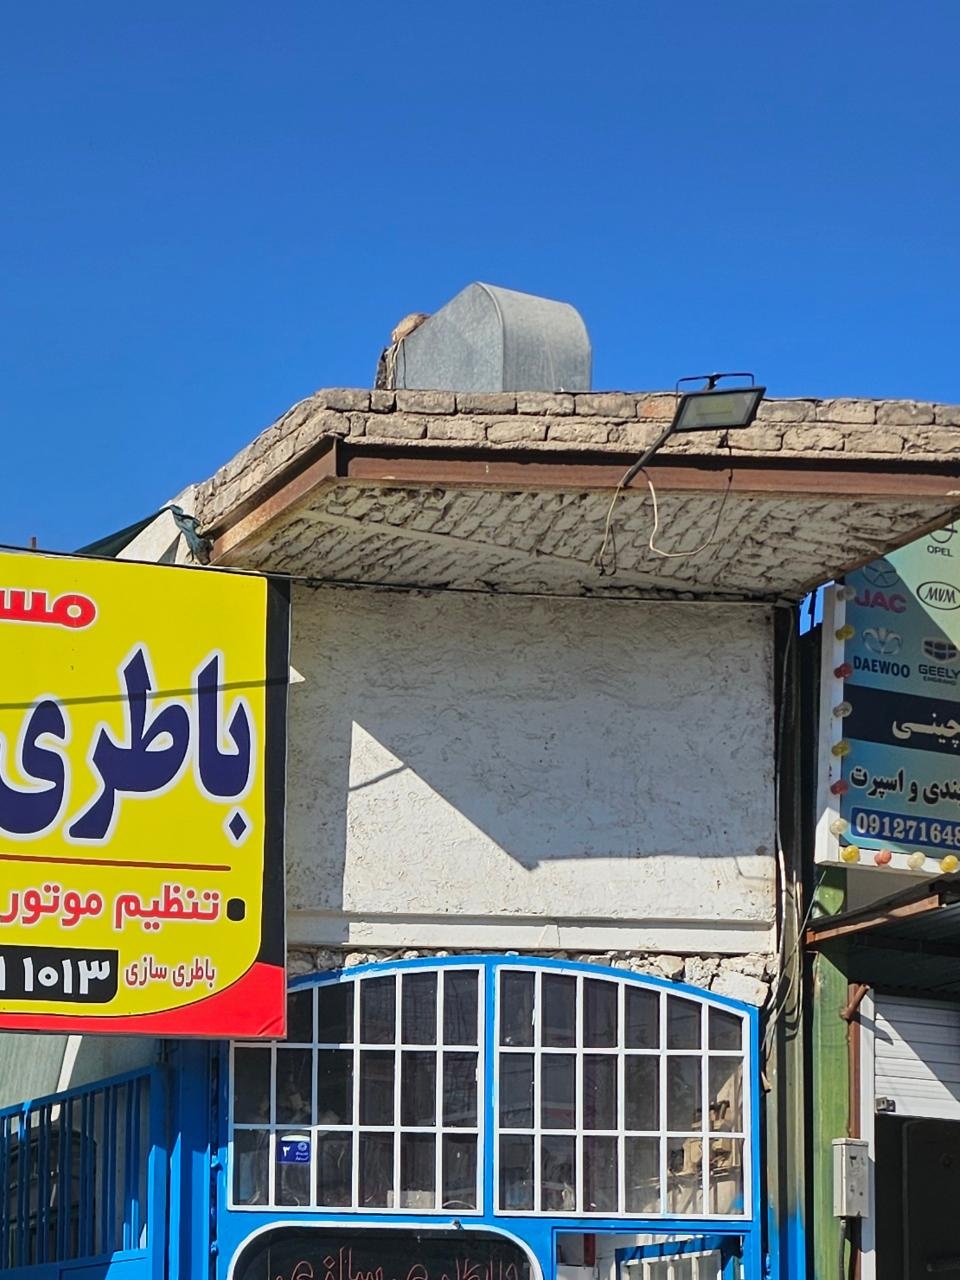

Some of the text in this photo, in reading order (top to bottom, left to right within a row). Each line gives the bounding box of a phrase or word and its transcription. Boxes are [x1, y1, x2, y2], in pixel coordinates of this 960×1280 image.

[927, 545, 954, 558] OPEL
[854, 589, 907, 614] JAC
[924, 586, 957, 604] MVM
[853, 655, 911, 679] DAEWOO
[918, 664, 960, 680] GEELY
[851, 768, 904, 799] اسپرت
[908, 781, 919, 802] و
[0, 884, 220, 930] تنظیم موتور
[22, 956, 111, 995] ۱۰۱۳
[125, 957, 216, 989] باطری سازی
